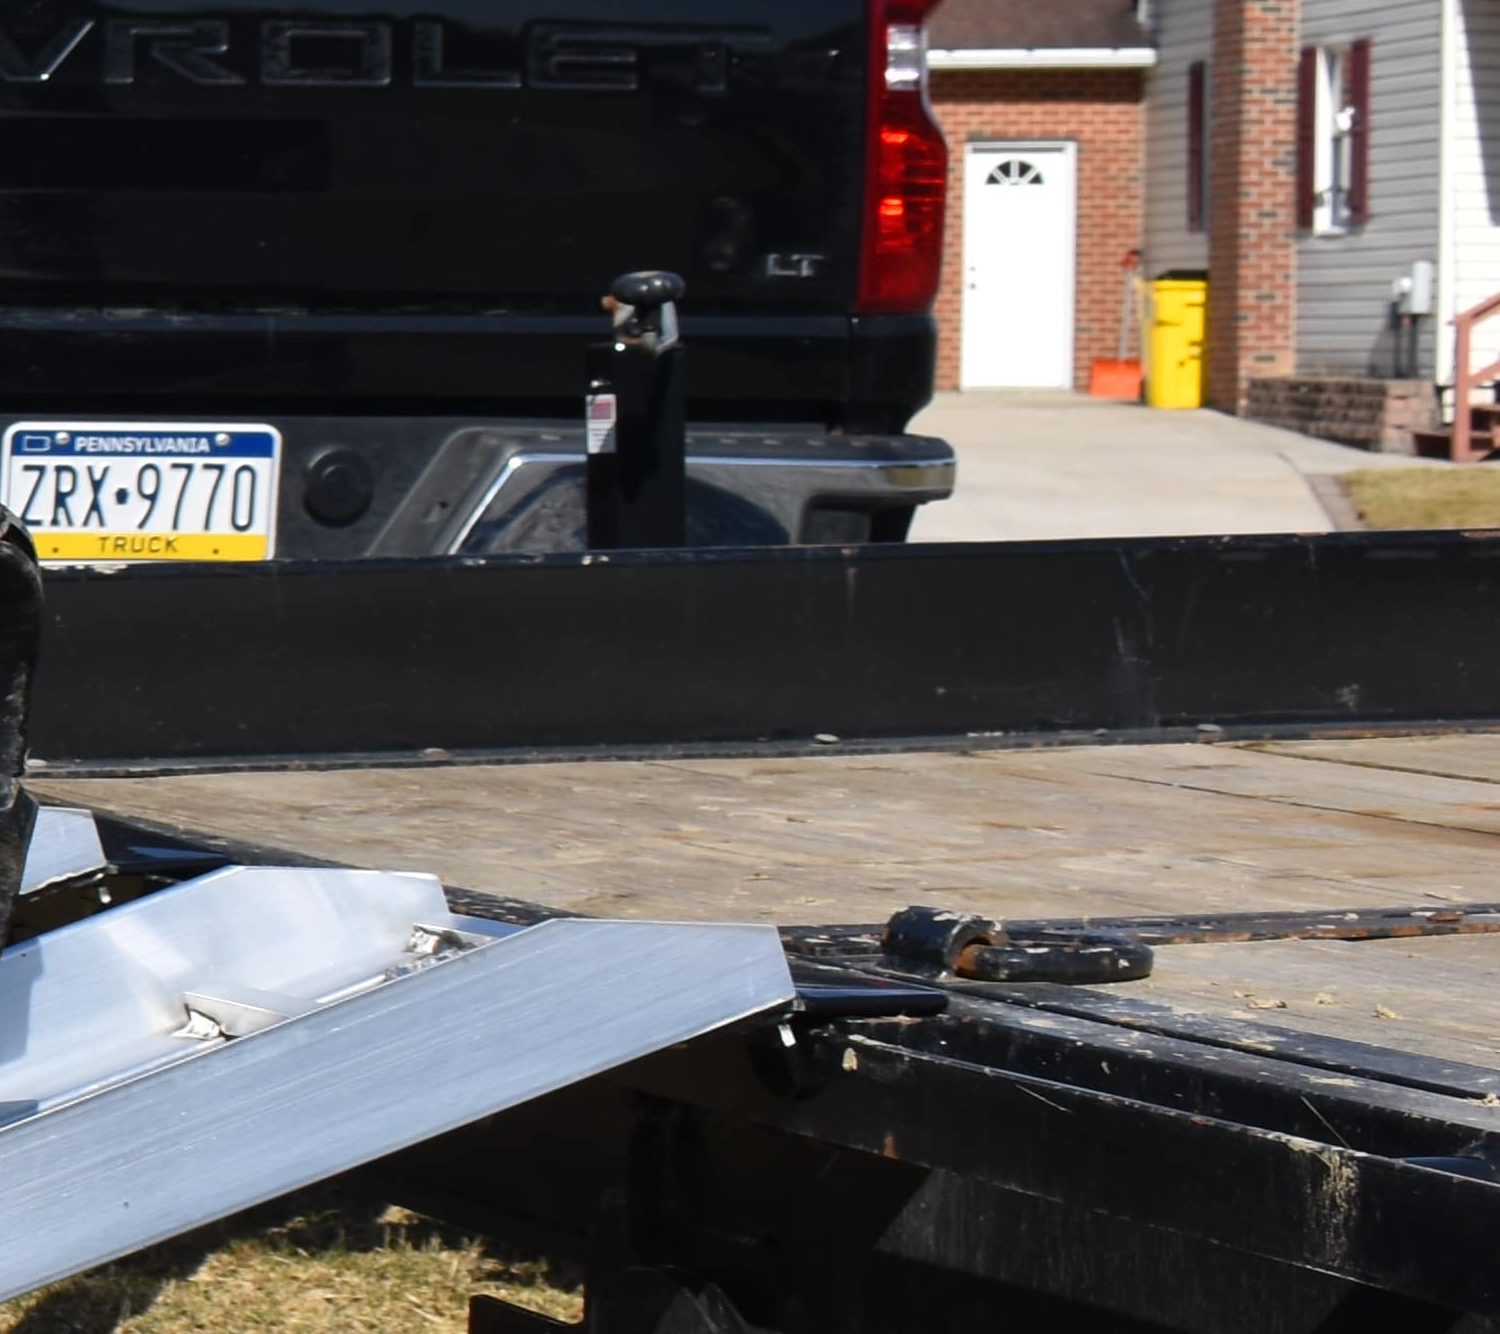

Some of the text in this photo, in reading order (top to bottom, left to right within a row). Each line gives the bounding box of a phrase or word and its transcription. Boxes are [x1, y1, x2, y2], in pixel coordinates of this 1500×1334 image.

[766, 253, 826, 277] LT
[74, 436, 210, 453] PENNSYLVANIA
[98, 536, 179, 553] TRUCK
